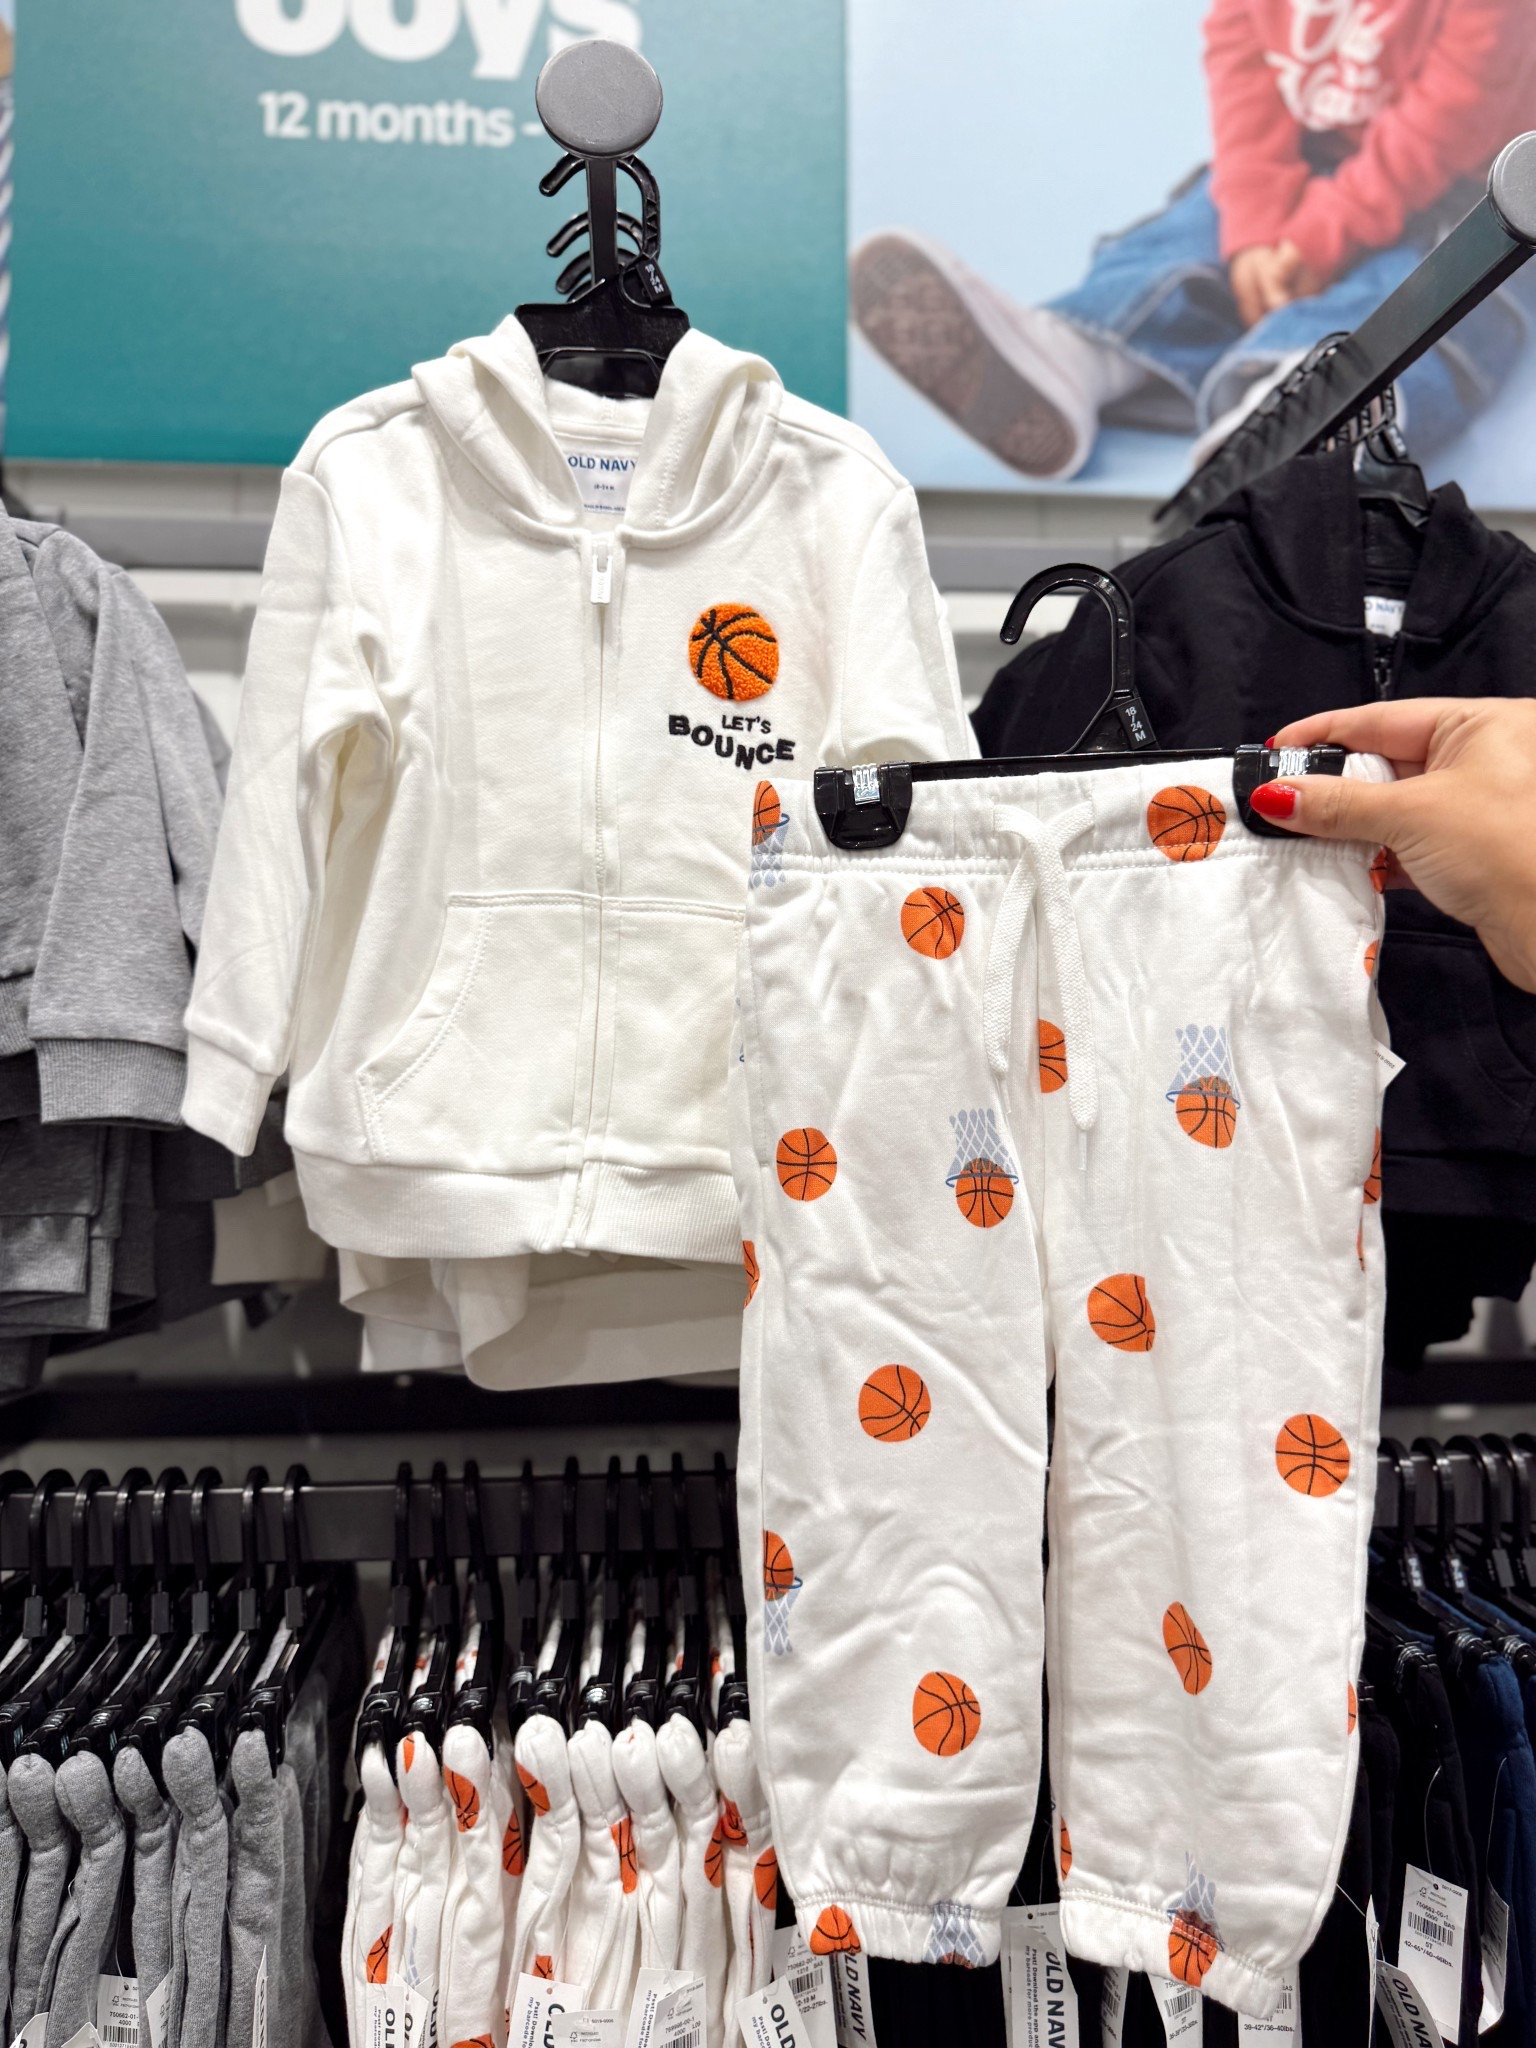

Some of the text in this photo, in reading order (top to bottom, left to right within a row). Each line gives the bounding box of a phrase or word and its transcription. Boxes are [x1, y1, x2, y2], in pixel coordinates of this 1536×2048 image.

[258, 91, 310, 138] 12
[317, 98, 516, 147] months
[568, 456, 637, 471] OLD NAVY
[721, 715, 771, 734] LET'S
[1125, 706, 1137, 717] 18
[1131, 720, 1143, 732] 24
[668, 714, 796, 770] BOUNCE
[1134, 730, 1146, 742] M
[844, 1952, 867, 2041] LD NAVY
[1046, 1951, 1066, 2048] OLD NAV
[1392, 1978, 1420, 2016] OLD
[1410, 2018, 1432, 2048] NA
[524, 2009, 532, 2040] barcode
[529, 2020, 537, 2048] Downlo
[640, 2003, 650, 2036] barcode
[643, 2014, 653, 2048] Downloa
[771, 2004, 796, 2048] OLD
